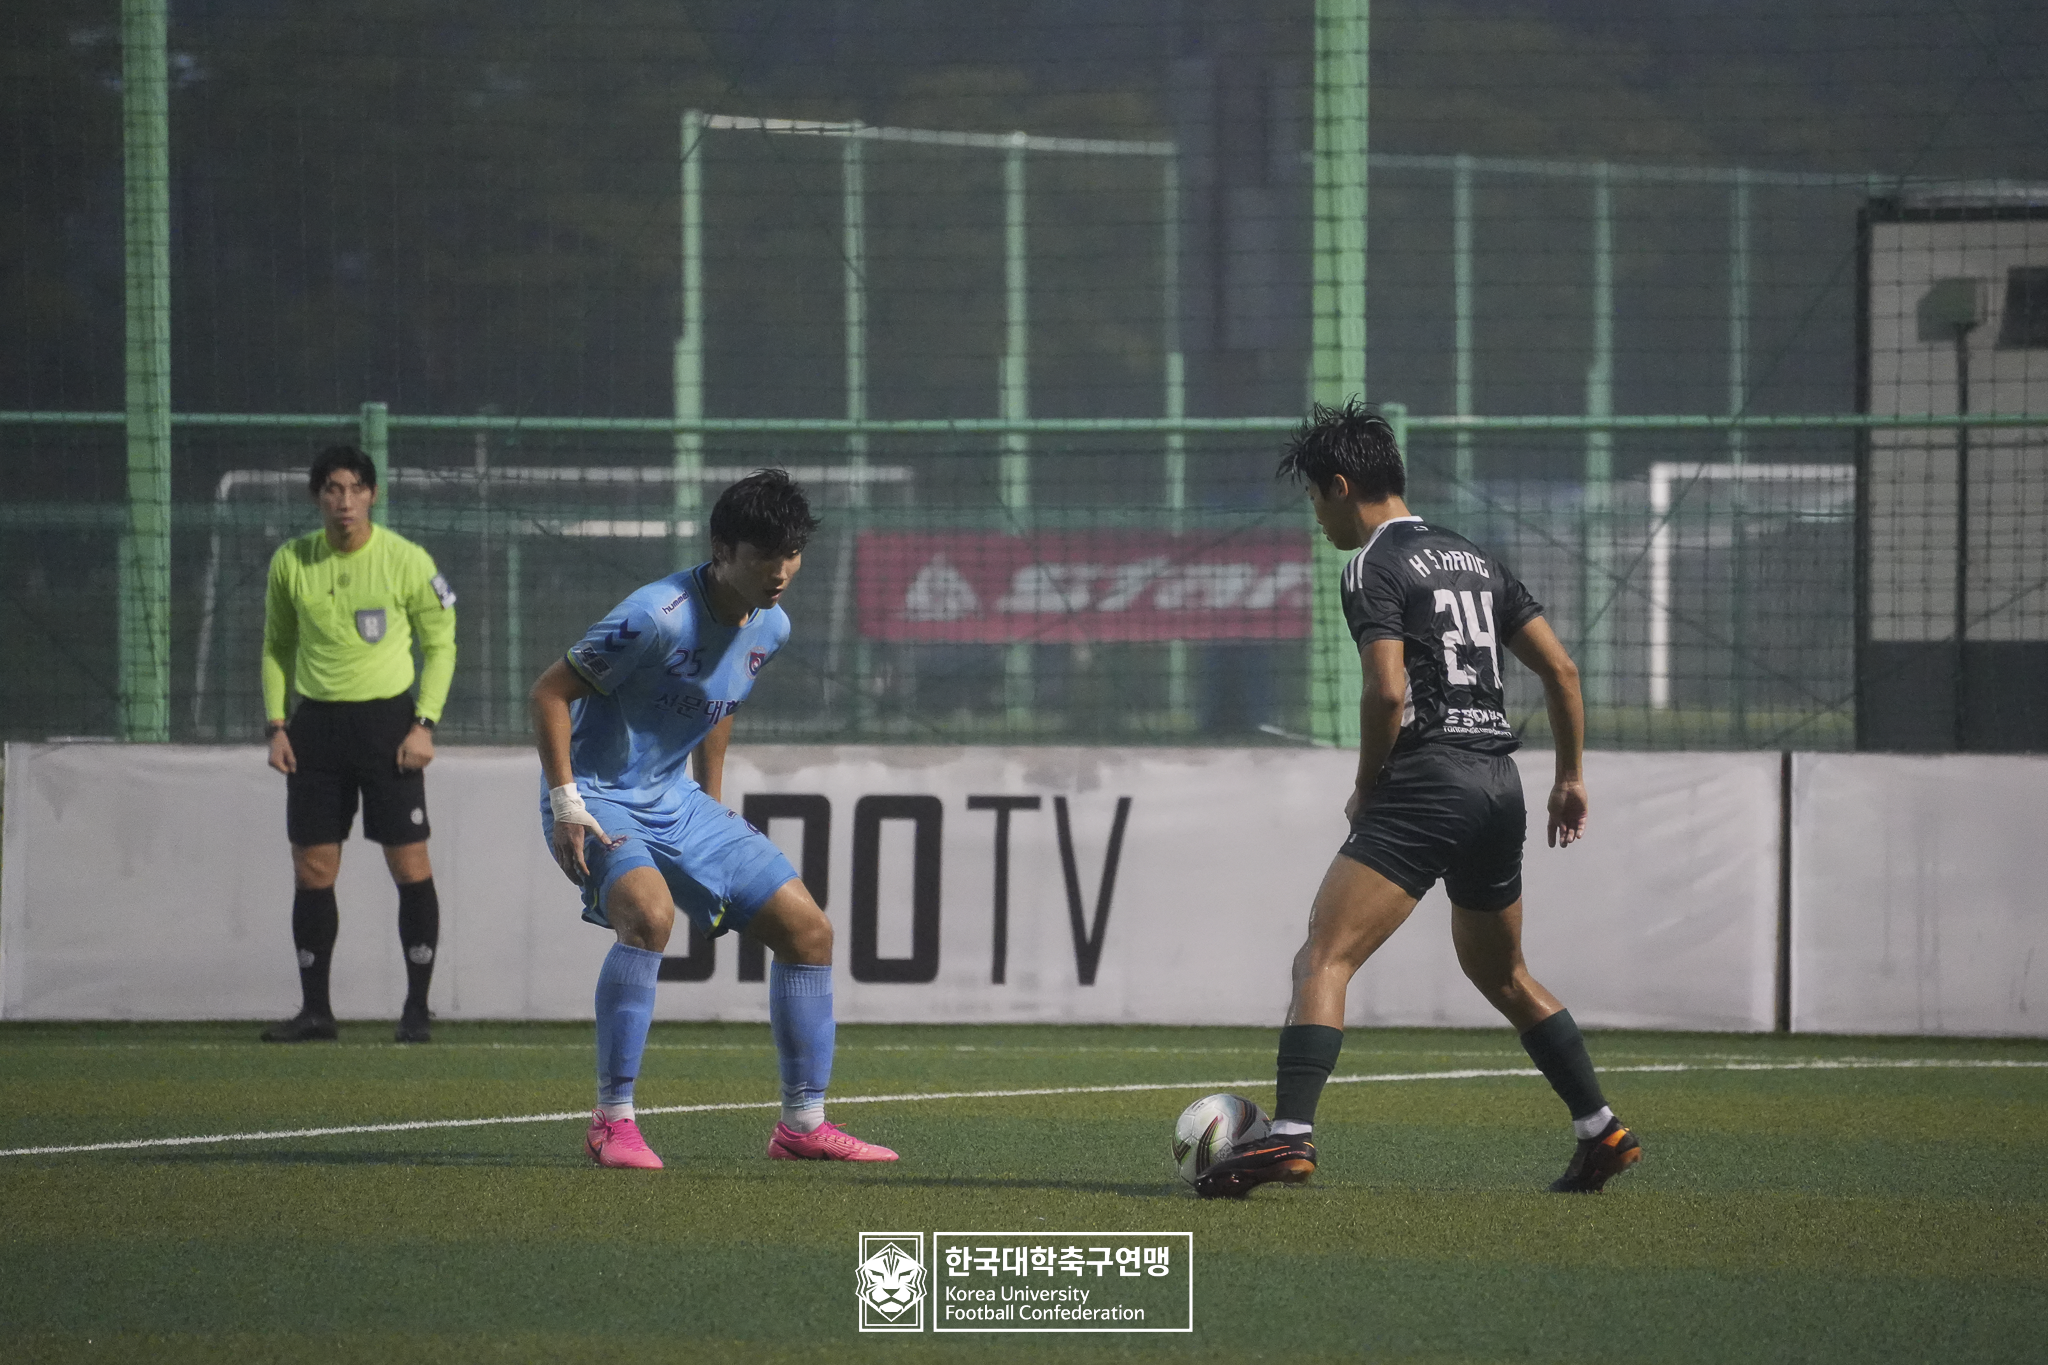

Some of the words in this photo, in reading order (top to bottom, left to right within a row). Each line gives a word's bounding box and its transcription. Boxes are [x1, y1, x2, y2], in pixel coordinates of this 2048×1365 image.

[1409, 554, 1431, 578] H
[661, 589, 690, 614] hummel
[1433, 588, 1503, 690] 24
[667, 647, 706, 680] 25
[658, 794, 1132, 986] POTV
